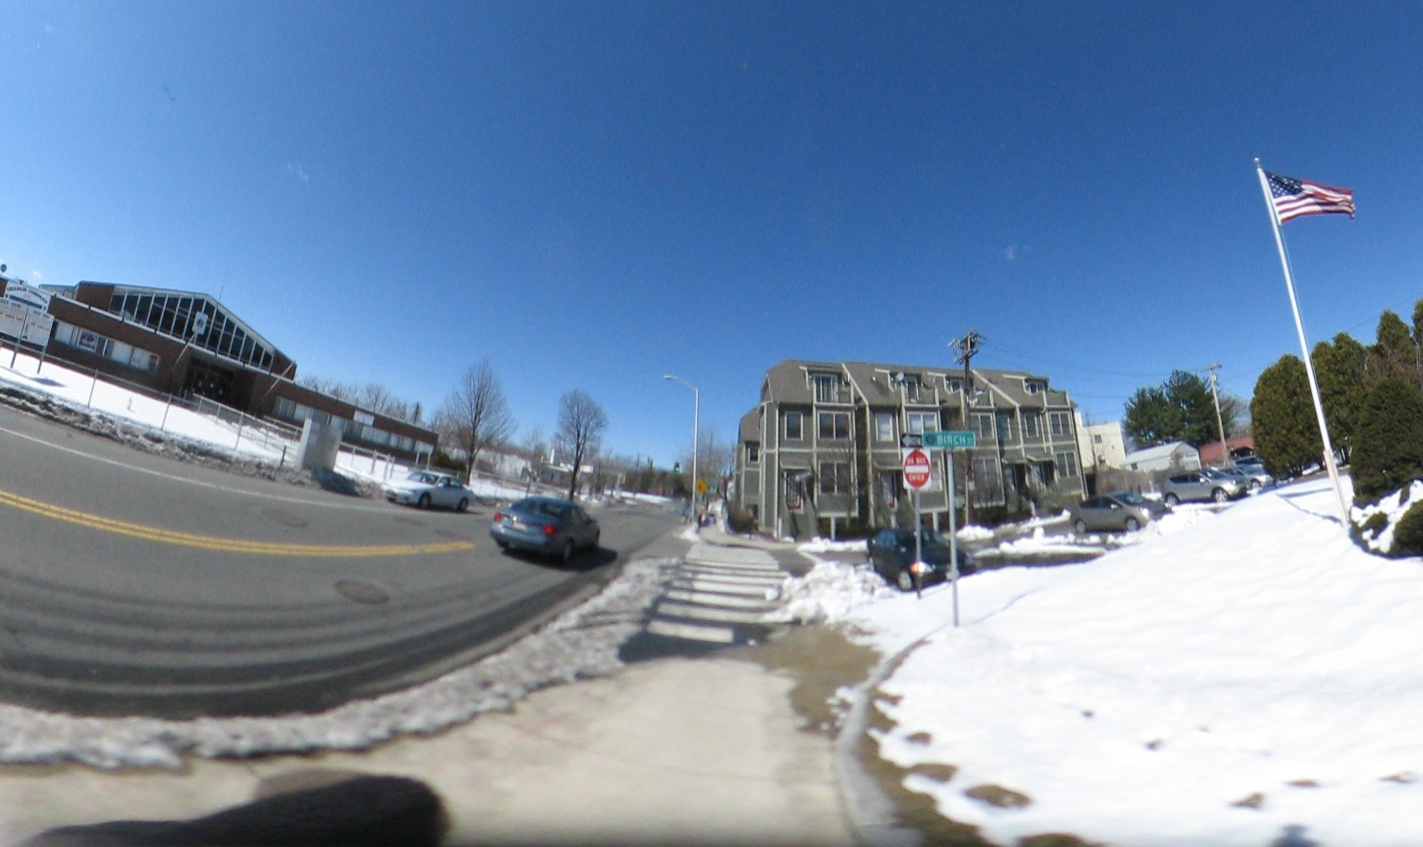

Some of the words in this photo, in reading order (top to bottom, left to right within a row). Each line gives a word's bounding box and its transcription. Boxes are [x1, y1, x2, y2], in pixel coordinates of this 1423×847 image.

[937, 434, 966, 445] BIRCH
[907, 457, 915, 465] DO
[916, 457, 926, 465] NOT
[908, 473, 925, 481] ENTER
